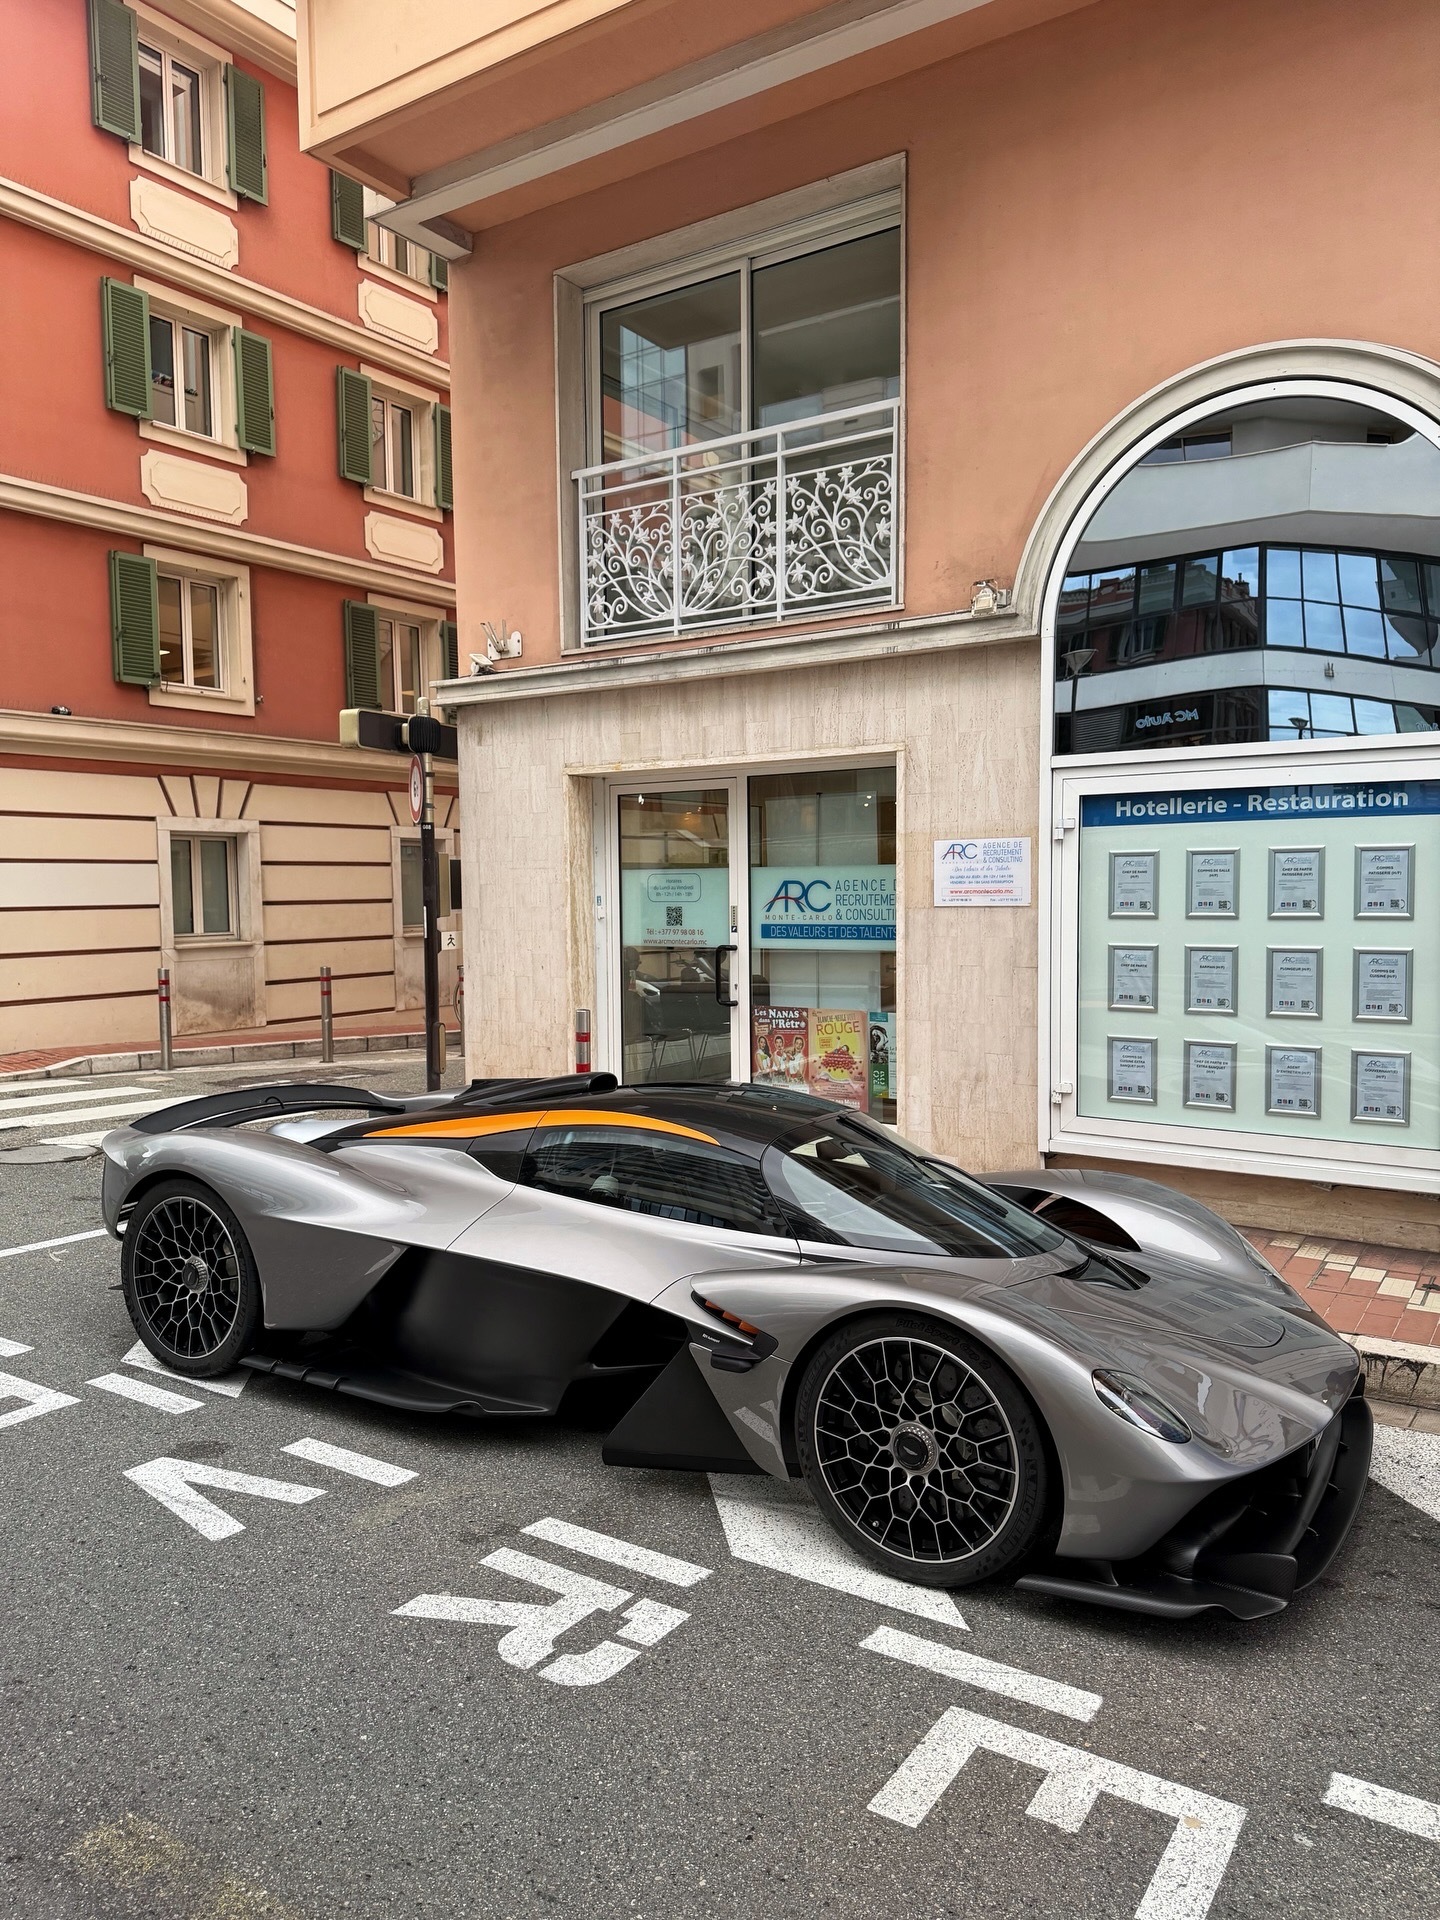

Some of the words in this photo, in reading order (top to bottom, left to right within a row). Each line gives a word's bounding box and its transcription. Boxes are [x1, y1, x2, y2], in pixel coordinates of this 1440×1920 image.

[1116, 796, 1228, 818] Hotellerie
[1248, 789, 1409, 812] Restauration
[942, 843, 978, 860] ARC
[835, 879, 886, 892] AGENCE
[765, 880, 832, 913] ARC
[836, 909, 843, 921] &
[770, 926, 787, 937] DES
[788, 926, 826, 938] VALEURS
[828, 926, 838, 938] ET
[840, 927, 858, 938] DES
[768, 1009, 800, 1019] NANAS
[816, 1021, 860, 1035] ROUGE
